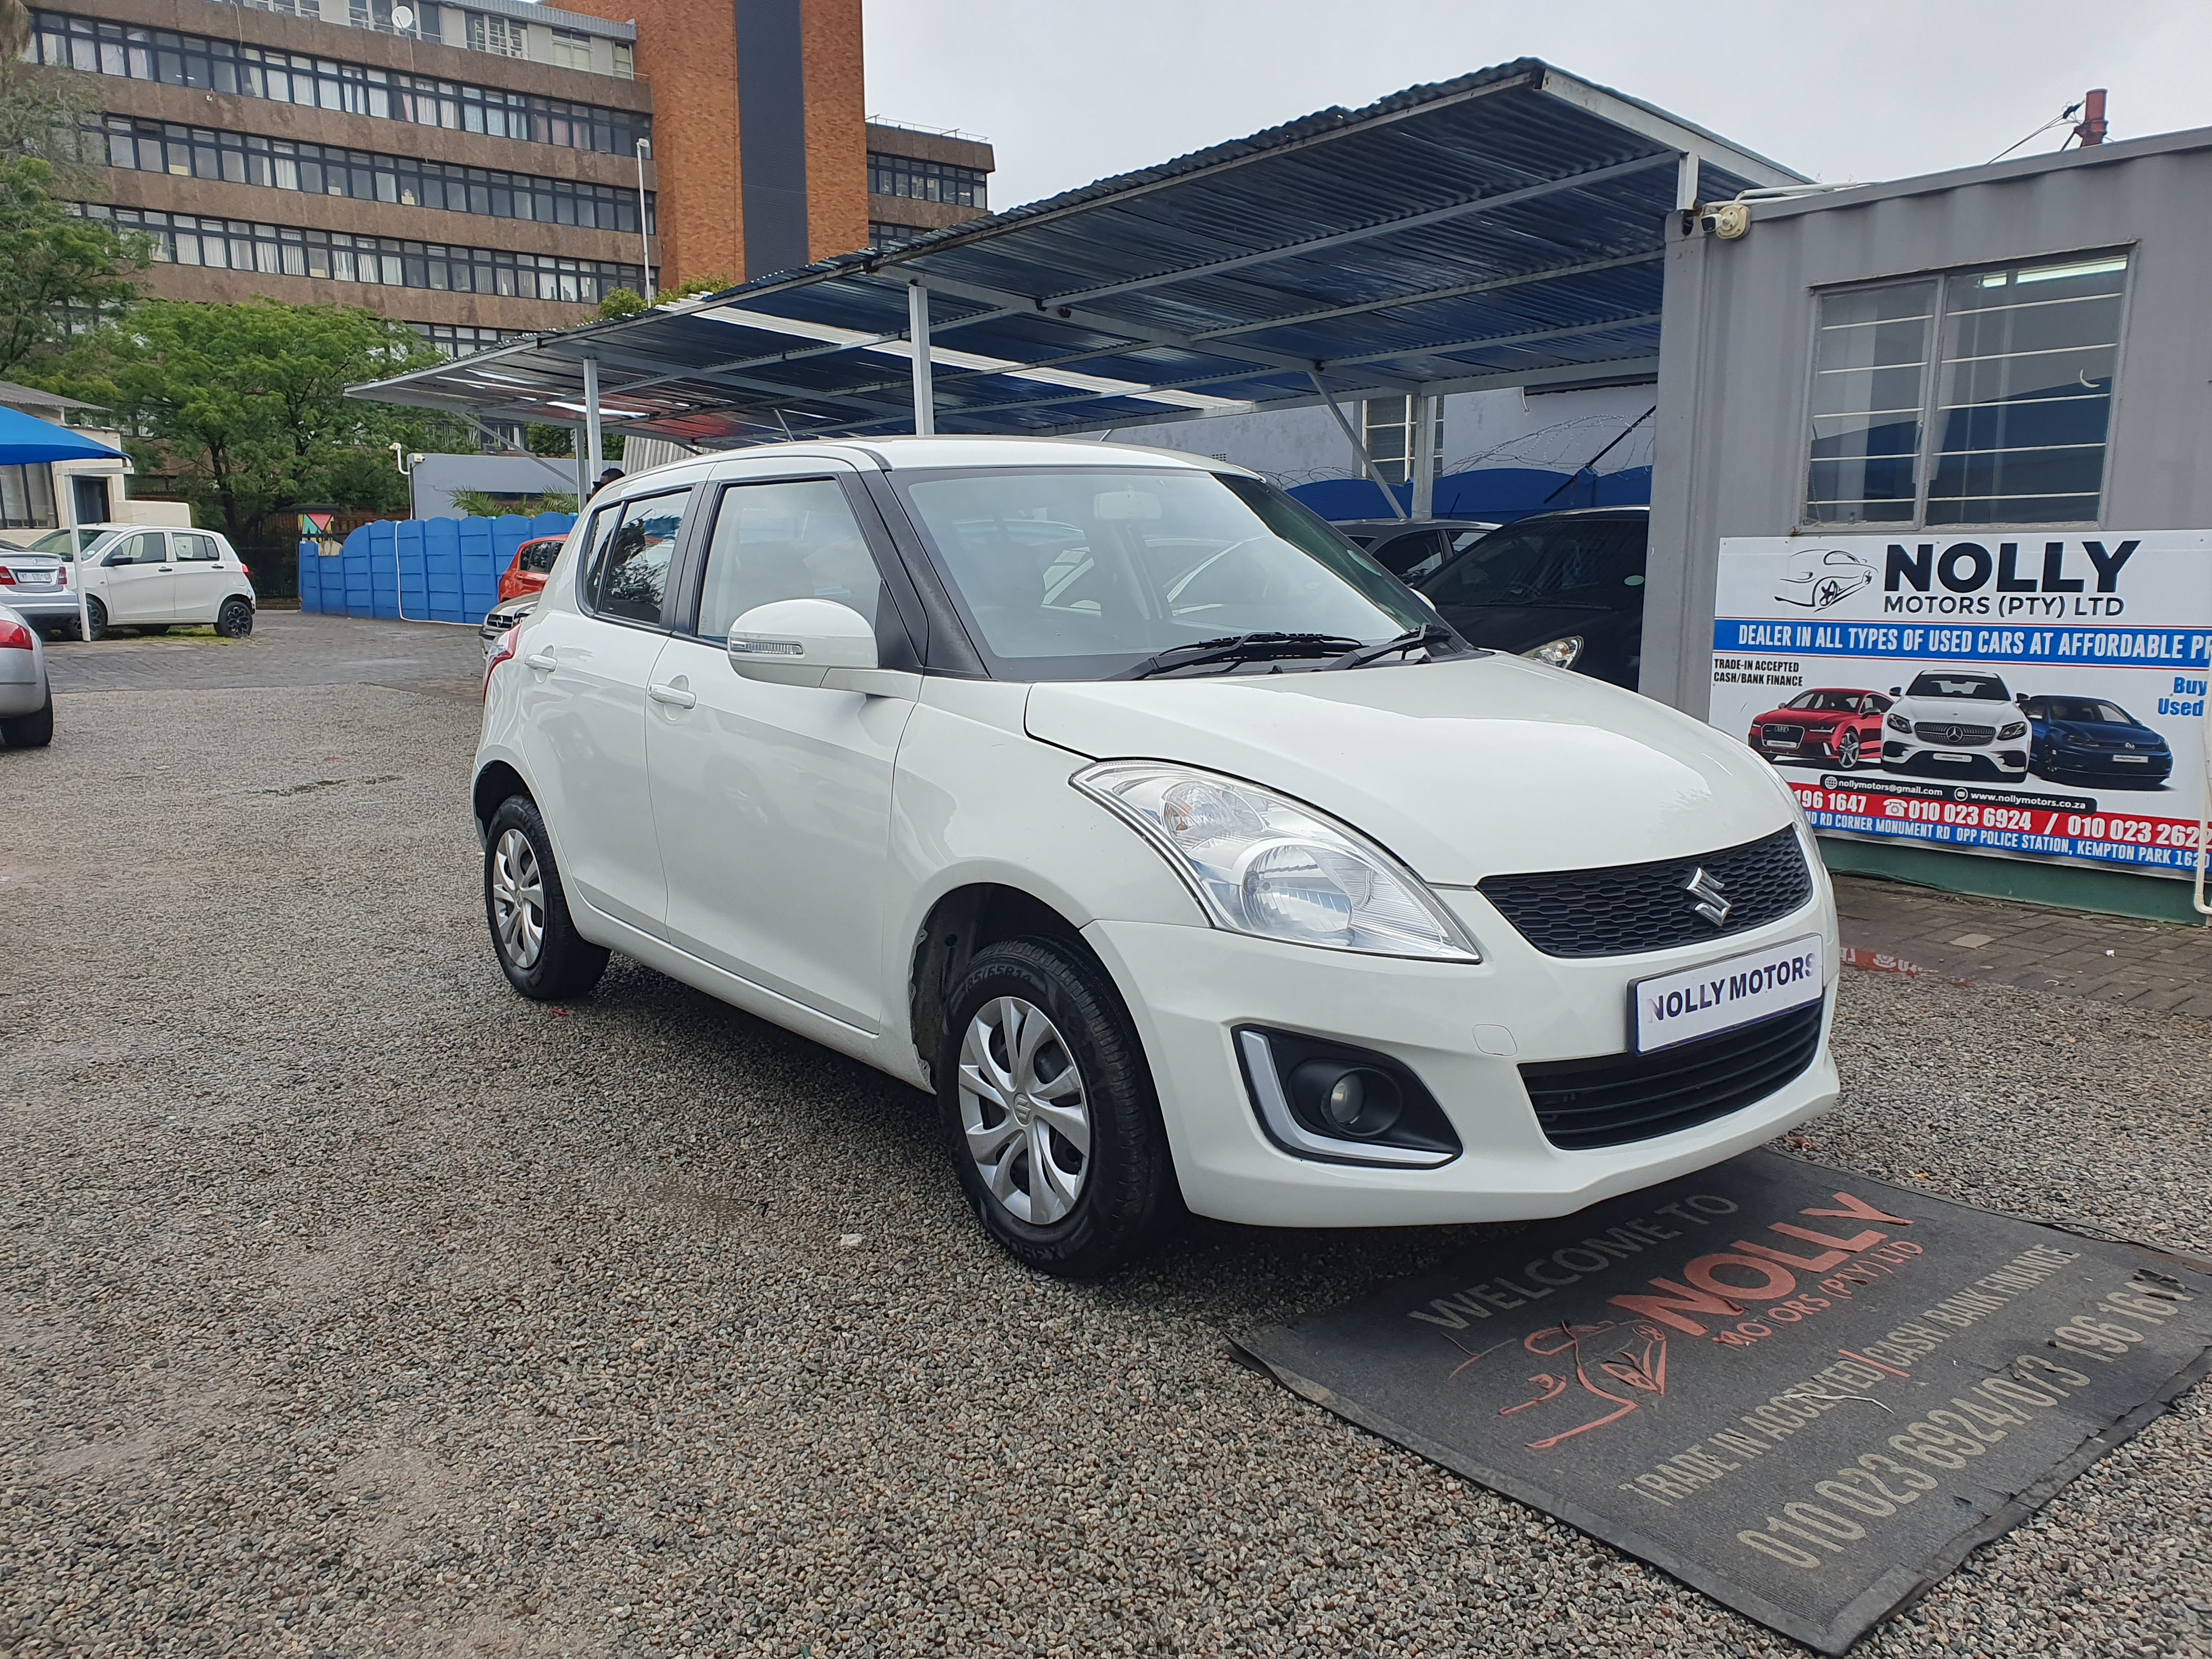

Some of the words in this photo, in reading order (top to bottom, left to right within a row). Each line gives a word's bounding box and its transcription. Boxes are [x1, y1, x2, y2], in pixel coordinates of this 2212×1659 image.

[1884, 540, 2141, 594] NOLLY
[1884, 596, 1990, 614] MOTORS
[1998, 595, 2066, 618] (PTY)
[2074, 597, 2124, 616] LTD
[1739, 624, 1791, 646] DEALER
[1796, 627, 1811, 647] IN
[1815, 627, 1842, 648] ALL
[1848, 628, 1898, 650] TYPES
[1903, 629, 1923, 651] OF
[1928, 630, 1973, 652] USED
[1978, 631, 2024, 654] CARS
[2029, 632, 2054, 655] AT
[2058, 633, 2185, 658] AFFORDABLE
[2191, 635, 2212, 659] PR
[1714, 659, 1753, 670] TRADE-IN
[1754, 661, 1799, 672] ACCEPTED
[1714, 672, 1764, 684] CASH/BANK
[1766, 674, 1803, 686] FINANCE
[2174, 676, 2208, 696] Buy
[2158, 698, 2204, 716] Used
[1838, 780, 1943, 796] nollymotors@gmail.com
[1971, 792, 2086, 810] www.nollymotors.co.za
[1793, 789, 1824, 809] 196
[1827, 793, 1867, 813] 1647
[1909, 800, 1940, 821] 010
[1944, 804, 1979, 825] 023
[1983, 808, 2031, 831] 6924
[2043, 812, 2059, 834] /
[2068, 815, 2105, 838] 010
[2109, 819, 2152, 843] 023
[1820, 812, 1833, 826] RD
[1835, 814, 1872, 831] CORNER
[1876, 818, 1933, 838] MONUMENT
[1936, 825, 1950, 840] RD
[1956, 827, 1977, 842] OPP
[1980, 830, 2018, 848] POLICE
[2022, 835, 2073, 855] STATION,
[2077, 840, 2135, 861] KEMPTON
[2138, 847, 2171, 865] PARK
[1647, 979, 1725, 1024] NOLLY
[1729, 953, 1816, 1001] MOTORS
[1407, 1217, 1683, 1329] WELCOME
[1654, 1194, 1738, 1225] TO
[1607, 1191, 1915, 1336] NOLLY
[1870, 1240, 1924, 1264] LTD
[1618, 1443, 1743, 1507] TRADE
[1707, 1427, 1773, 1459] IN
[1975, 1243, 2081, 1296] FINANCE
[1736, 1502, 1866, 1568] 010
[1815, 1454, 1938, 1517] 023
[2045, 1316, 2145, 1363] 196
